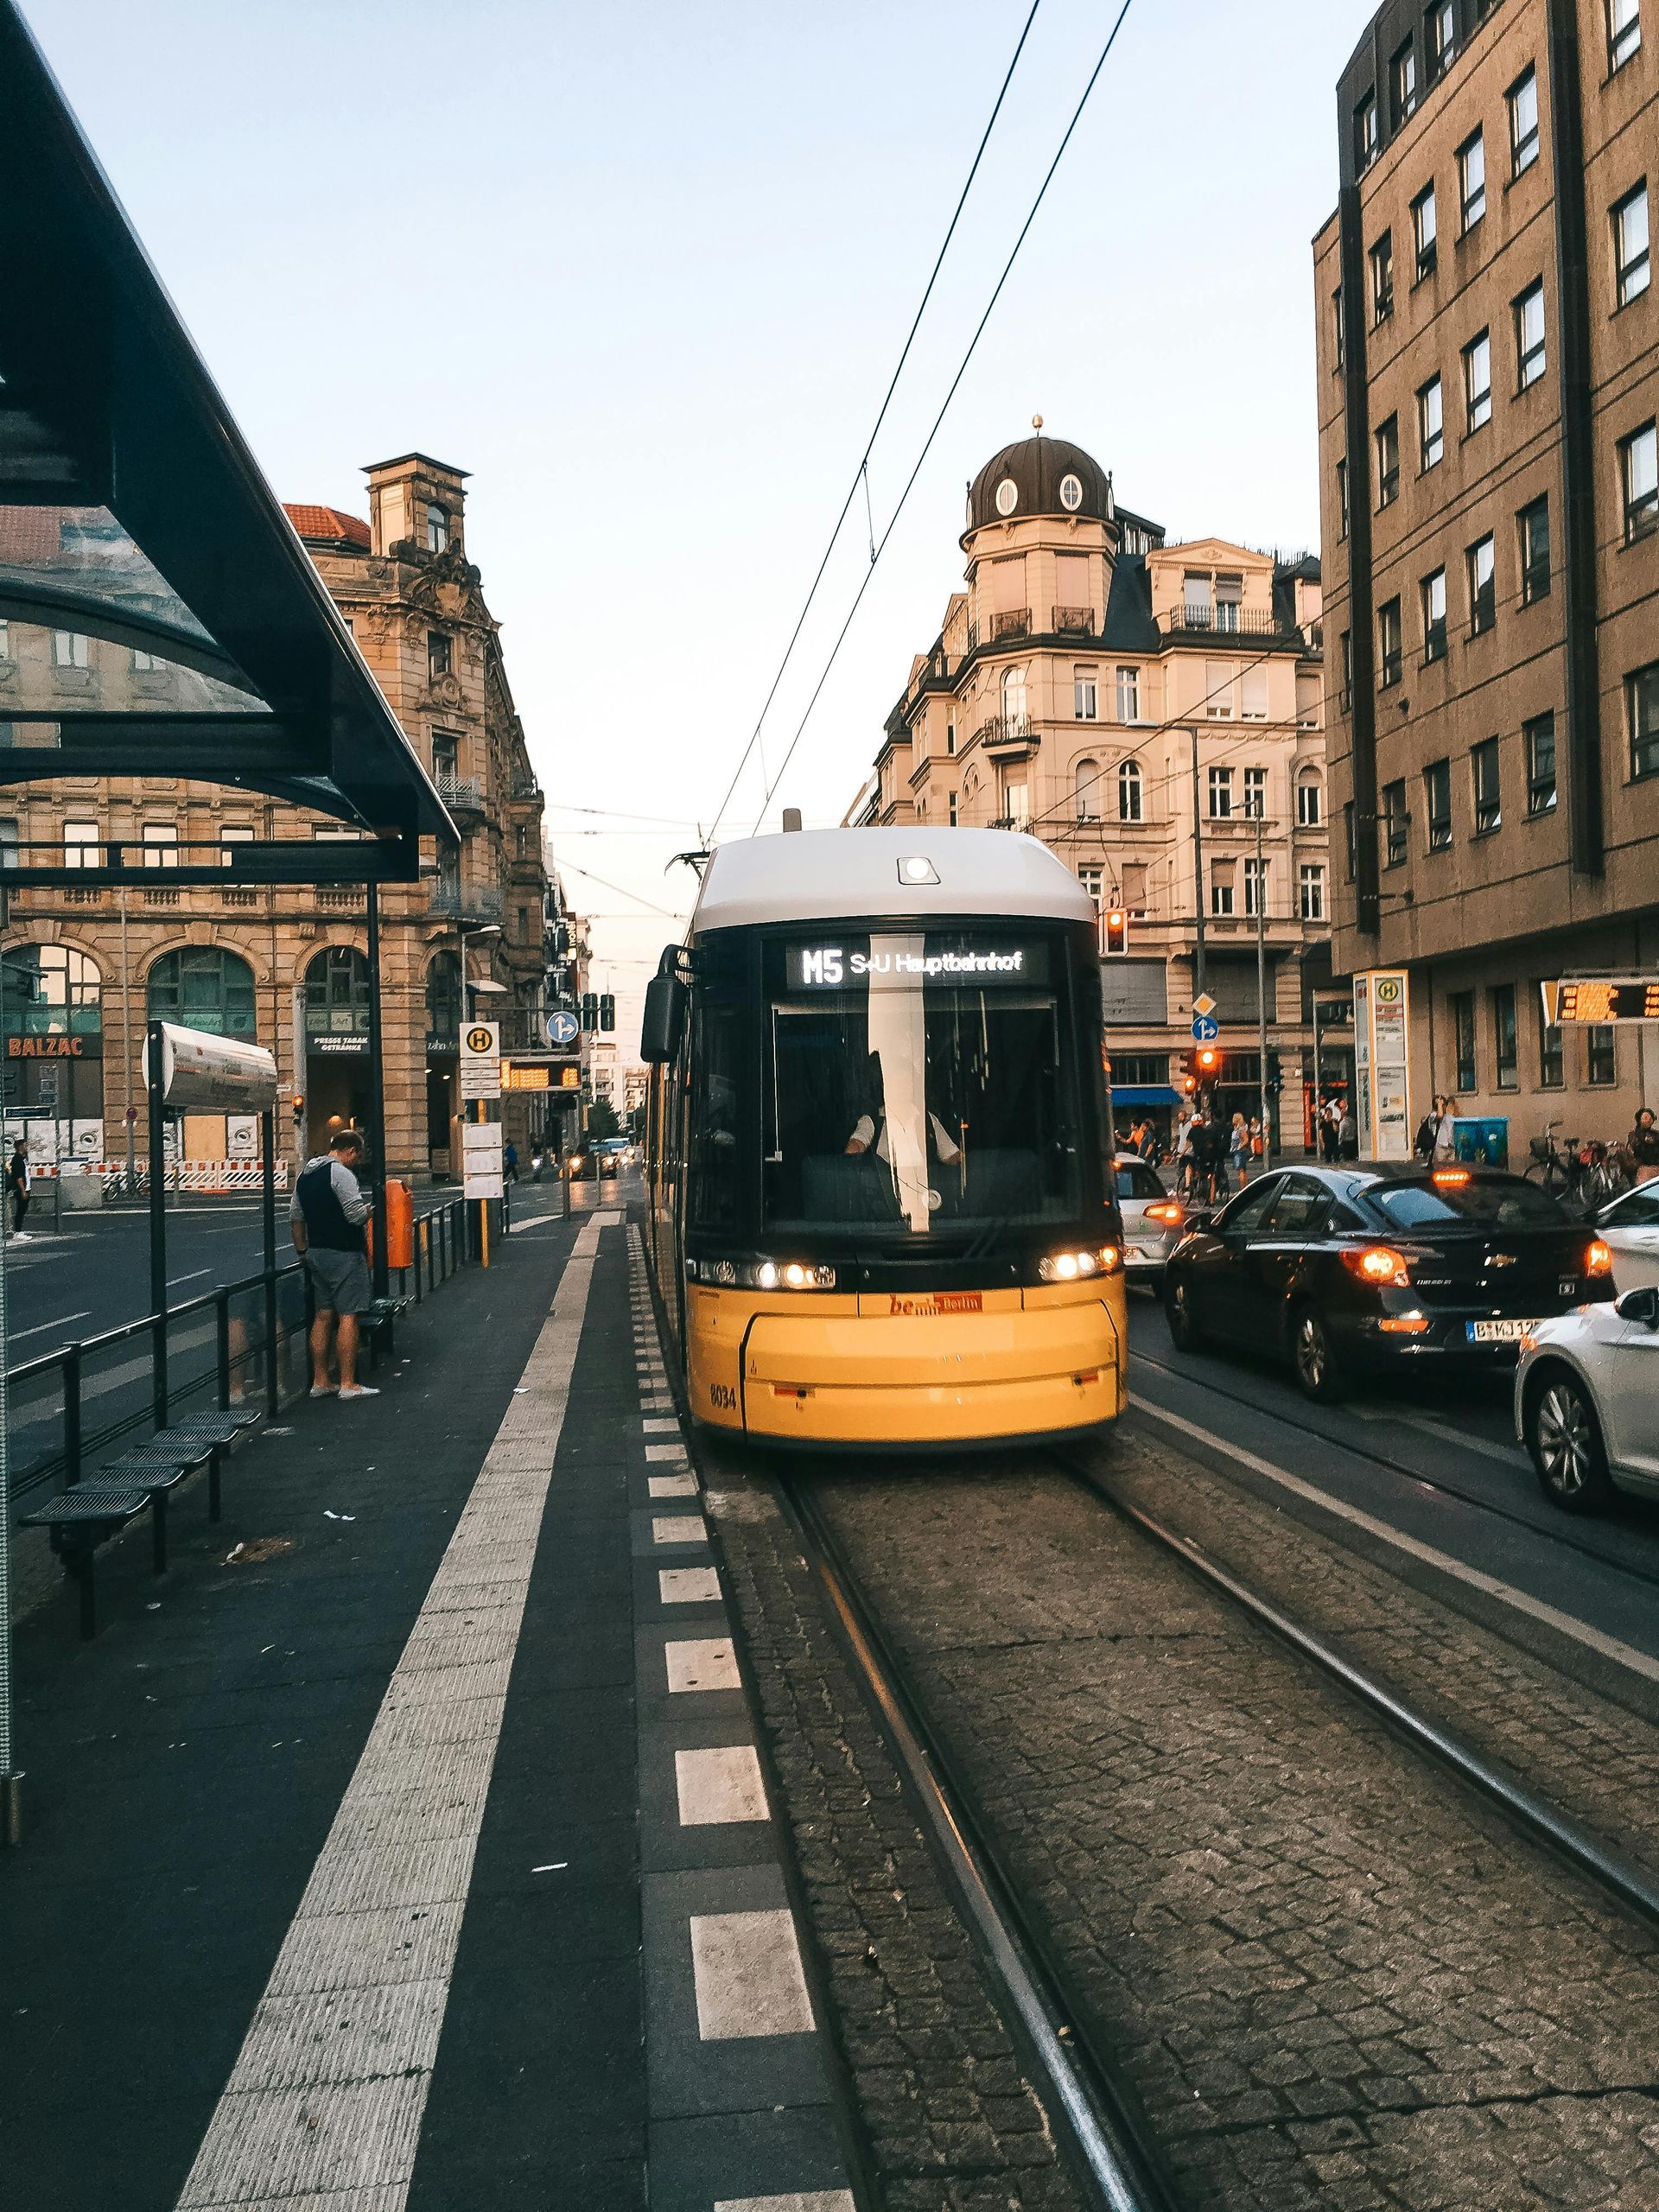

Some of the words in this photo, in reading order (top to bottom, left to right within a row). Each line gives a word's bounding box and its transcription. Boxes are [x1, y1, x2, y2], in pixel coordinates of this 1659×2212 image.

[803, 950, 843, 984] M5
[849, 953, 891, 974] S+U
[895, 950, 1024, 976] Hauptbahnhof
[9, 1037, 83, 1056] BALZAC
[889, 1294, 913, 1315] be
[943, 1295, 979, 1311] Berlin
[1477, 1322, 1486, 1338] B
[709, 1382, 737, 1410] 8034
